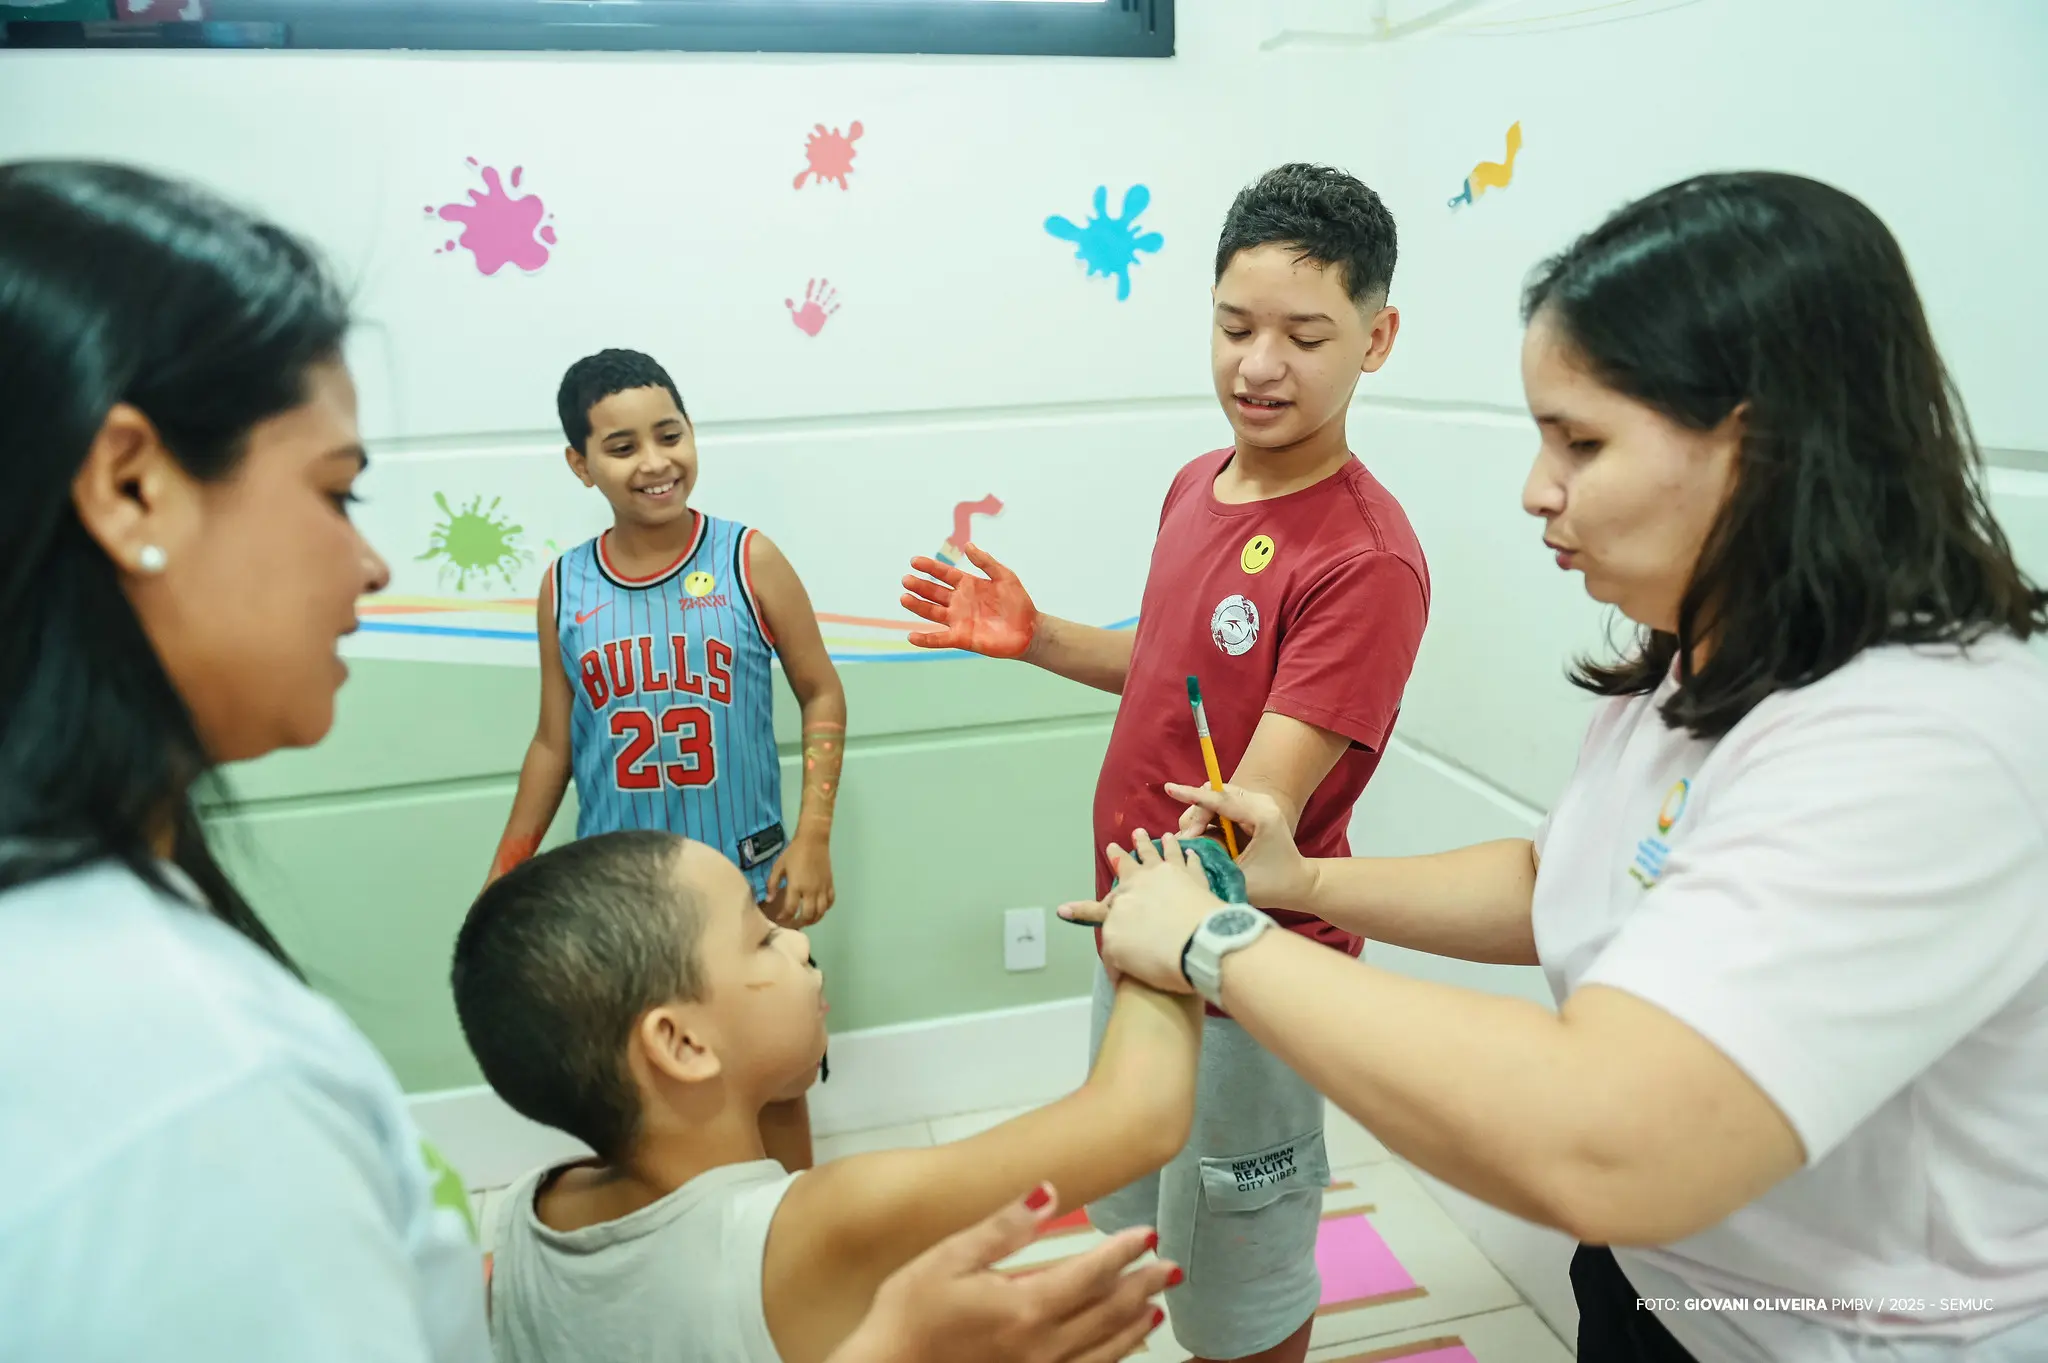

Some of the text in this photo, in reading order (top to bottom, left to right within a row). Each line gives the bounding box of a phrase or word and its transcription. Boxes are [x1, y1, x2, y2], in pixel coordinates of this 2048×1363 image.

[578, 633, 734, 712] BULLS
[608, 704, 718, 791] 23
[1232, 1147, 1294, 1171] NEW URBAN
[1233, 1155, 1293, 1182] REALITY
[1238, 1166, 1298, 1192] CITY VIBES
